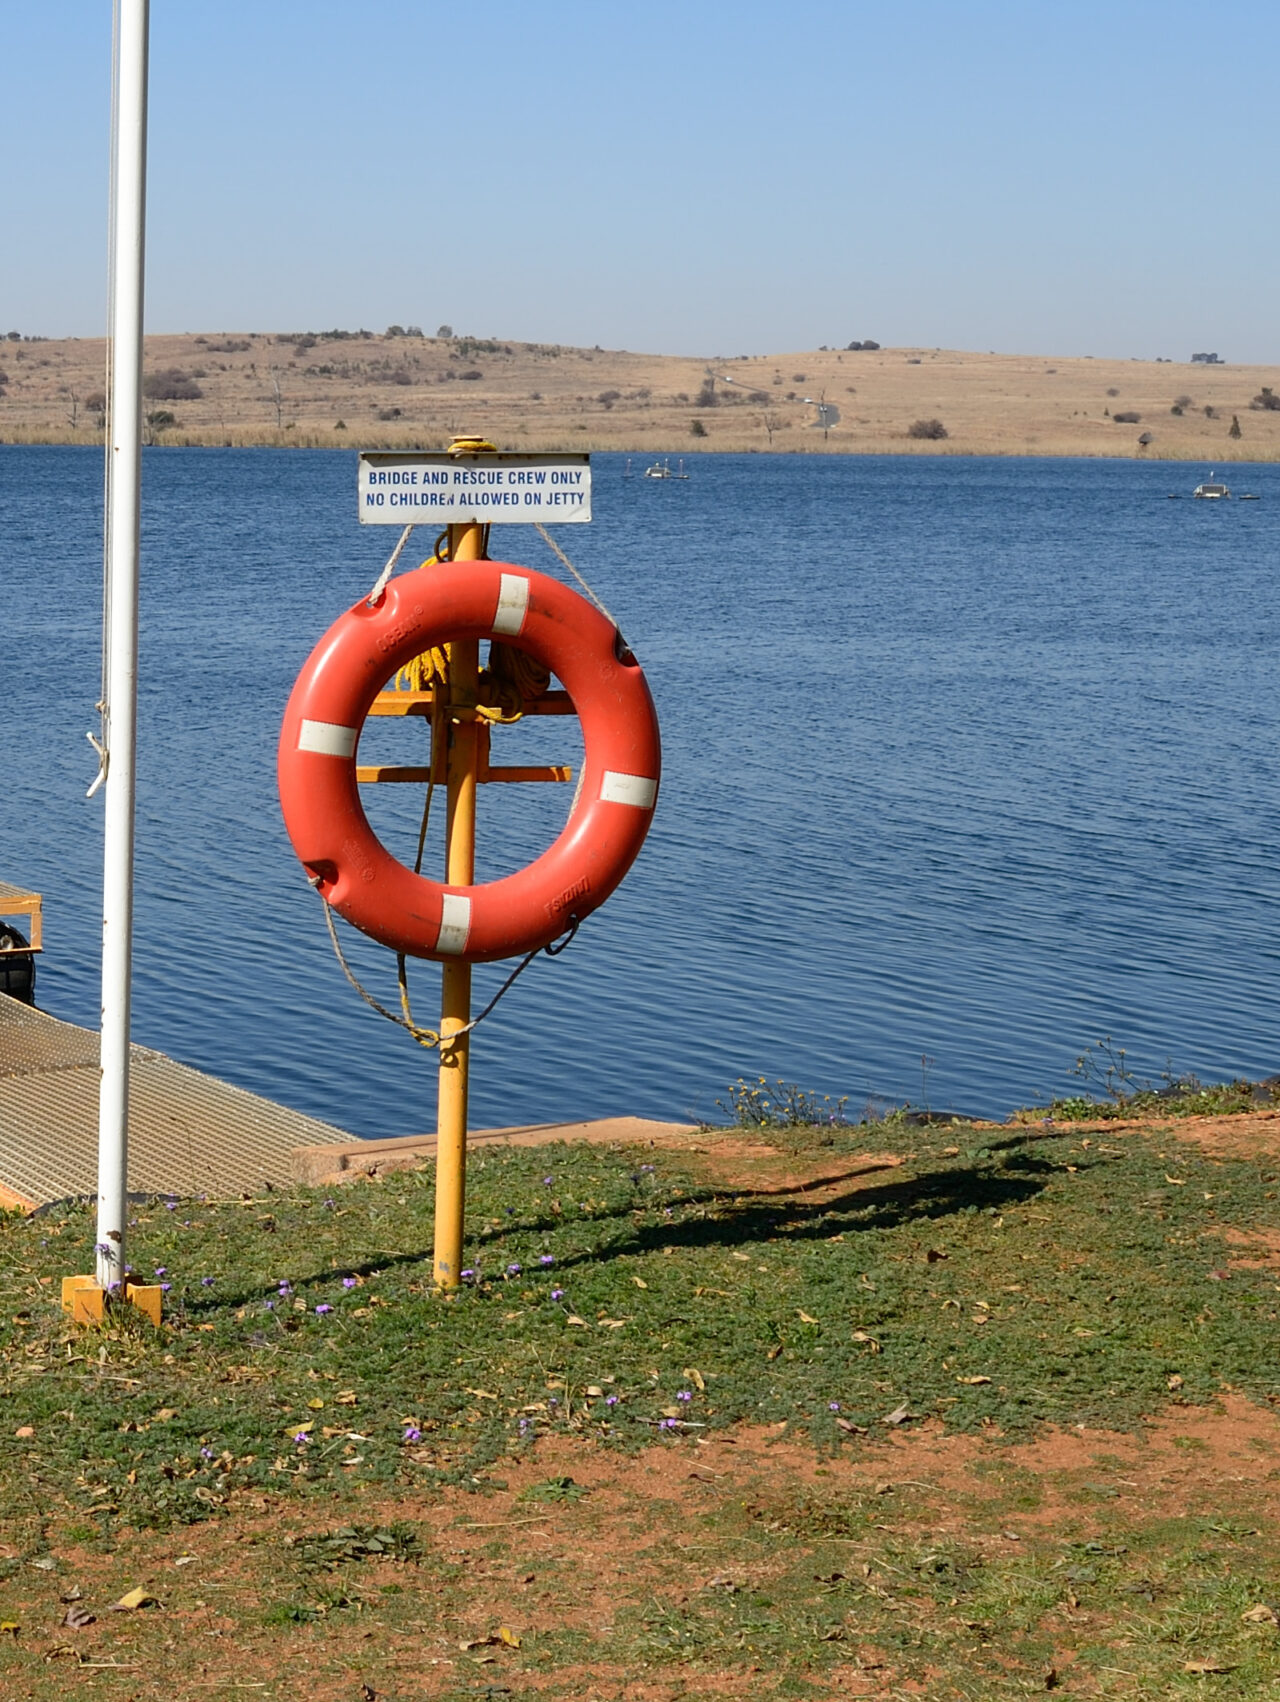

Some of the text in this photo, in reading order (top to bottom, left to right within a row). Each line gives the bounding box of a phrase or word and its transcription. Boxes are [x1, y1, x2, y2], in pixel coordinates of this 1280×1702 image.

[369, 471, 582, 485] BRIDGE AND RESCUE CREW ONLY
[366, 492, 585, 506] NO CHILDREN ALLOWED ON JETTY
